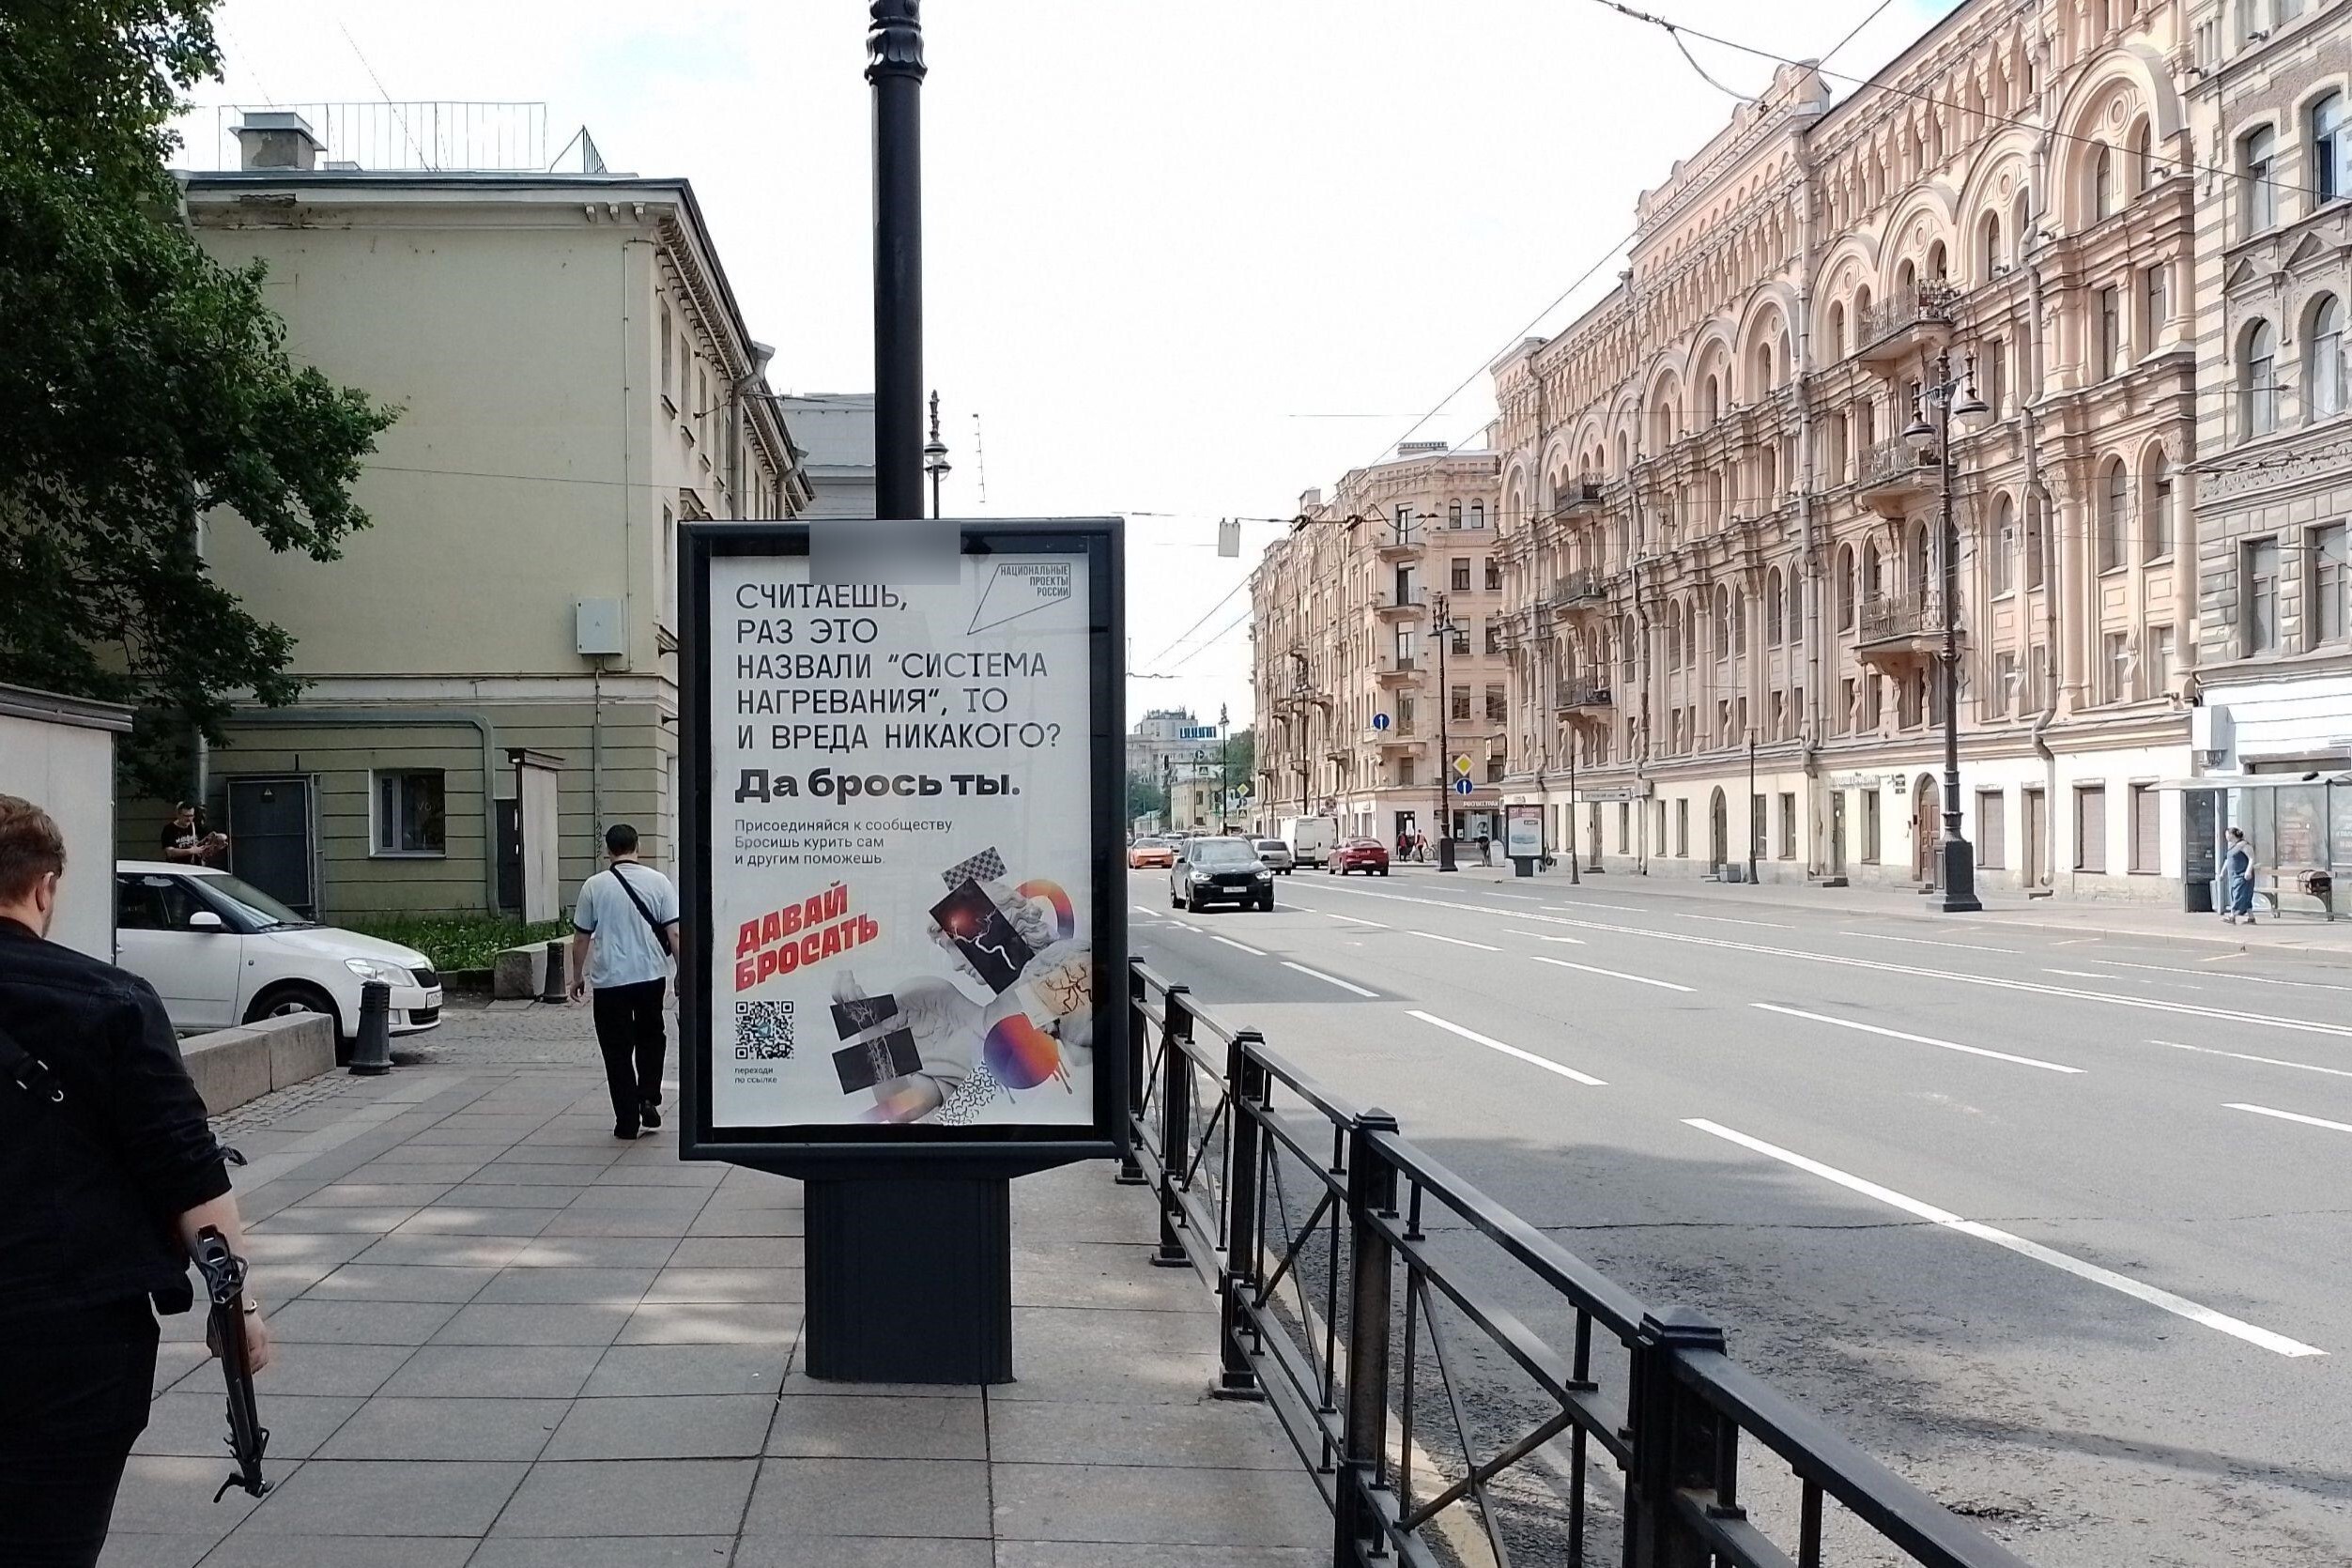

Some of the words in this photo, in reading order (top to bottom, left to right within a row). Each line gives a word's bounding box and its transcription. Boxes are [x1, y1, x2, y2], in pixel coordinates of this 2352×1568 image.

[1001, 565, 1068, 576] НАЦИОНАЛЬНЫЕ
[1029, 576, 1068, 586] ПРОЕКТЫ
[736, 583, 908, 611] СЧИТАЕШЬ,
[1037, 586, 1068, 597] РОССИИ
[737, 619, 793, 644] РАЗ
[810, 618, 879, 644] ЭТО
[738, 653, 871, 681] НАЗВАЛИ
[963, 687, 1008, 714] ТО
[738, 725, 754, 750] И
[773, 724, 869, 754] ВРЕДА
[884, 722, 1061, 749] НИКАКОГО?
[735, 769, 800, 804] Да
[807, 767, 943, 806] брось
[950, 774, 1021, 796] ты.
[734, 819, 850, 834] Присоединяйся
[853, 822, 861, 831] к
[734, 837, 800, 851] Бросишь
[804, 838, 853, 851] курить
[856, 838, 884, 848] сам
[734, 854, 744, 864] и
[746, 853, 799, 868] другим
[736, 880, 848, 960] ДАВАЙ
[735, 913, 879, 992] БРОСАТЬ
[734, 1068, 774, 1076] переходи
